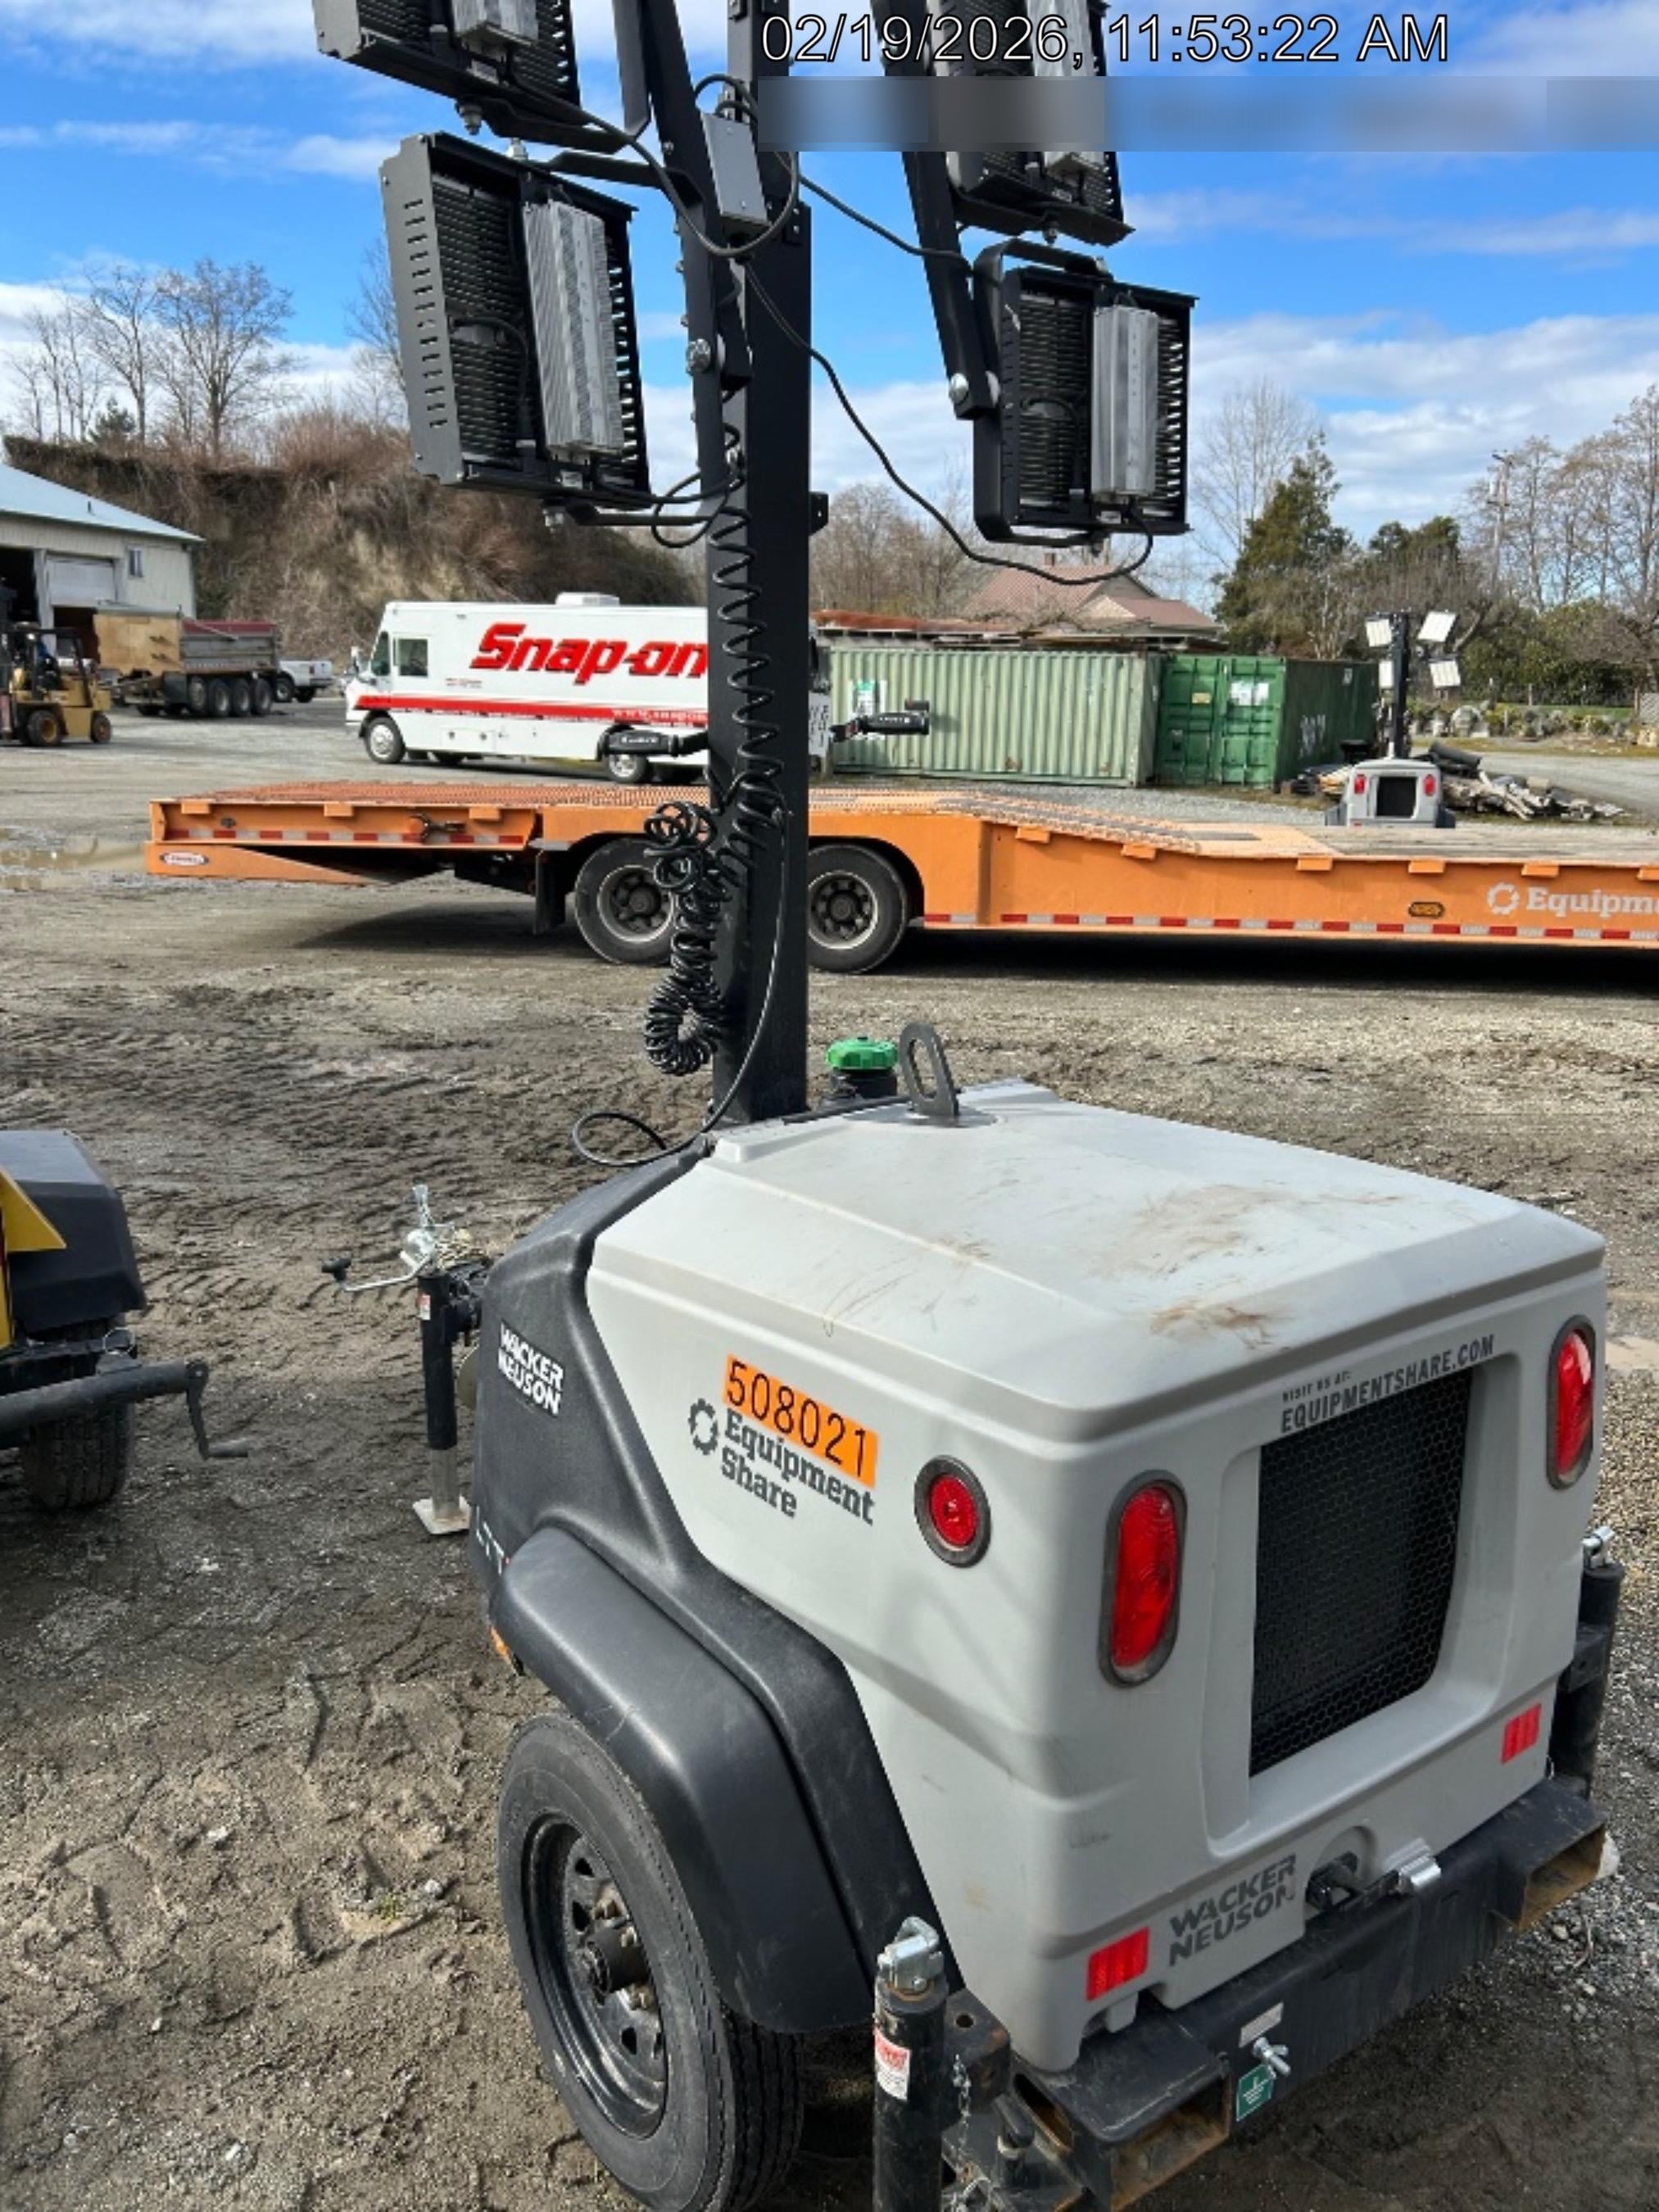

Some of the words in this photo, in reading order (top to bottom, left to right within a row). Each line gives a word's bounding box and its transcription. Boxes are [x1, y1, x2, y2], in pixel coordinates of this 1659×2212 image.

[469, 623, 708, 685] Snap-on
[498, 1348, 560, 1415] NEUSON
[500, 1321, 564, 1392] WACKER
[1281, 1335, 1494, 1433] EQUIPMENTSHARE.COM
[727, 1359, 866, 1478] 508021
[721, 1445, 797, 1518] Share
[725, 1407, 875, 1526] Equipment
[1169, 1884, 1294, 1967] NEUSON
[1170, 1854, 1296, 1938] WACKER
